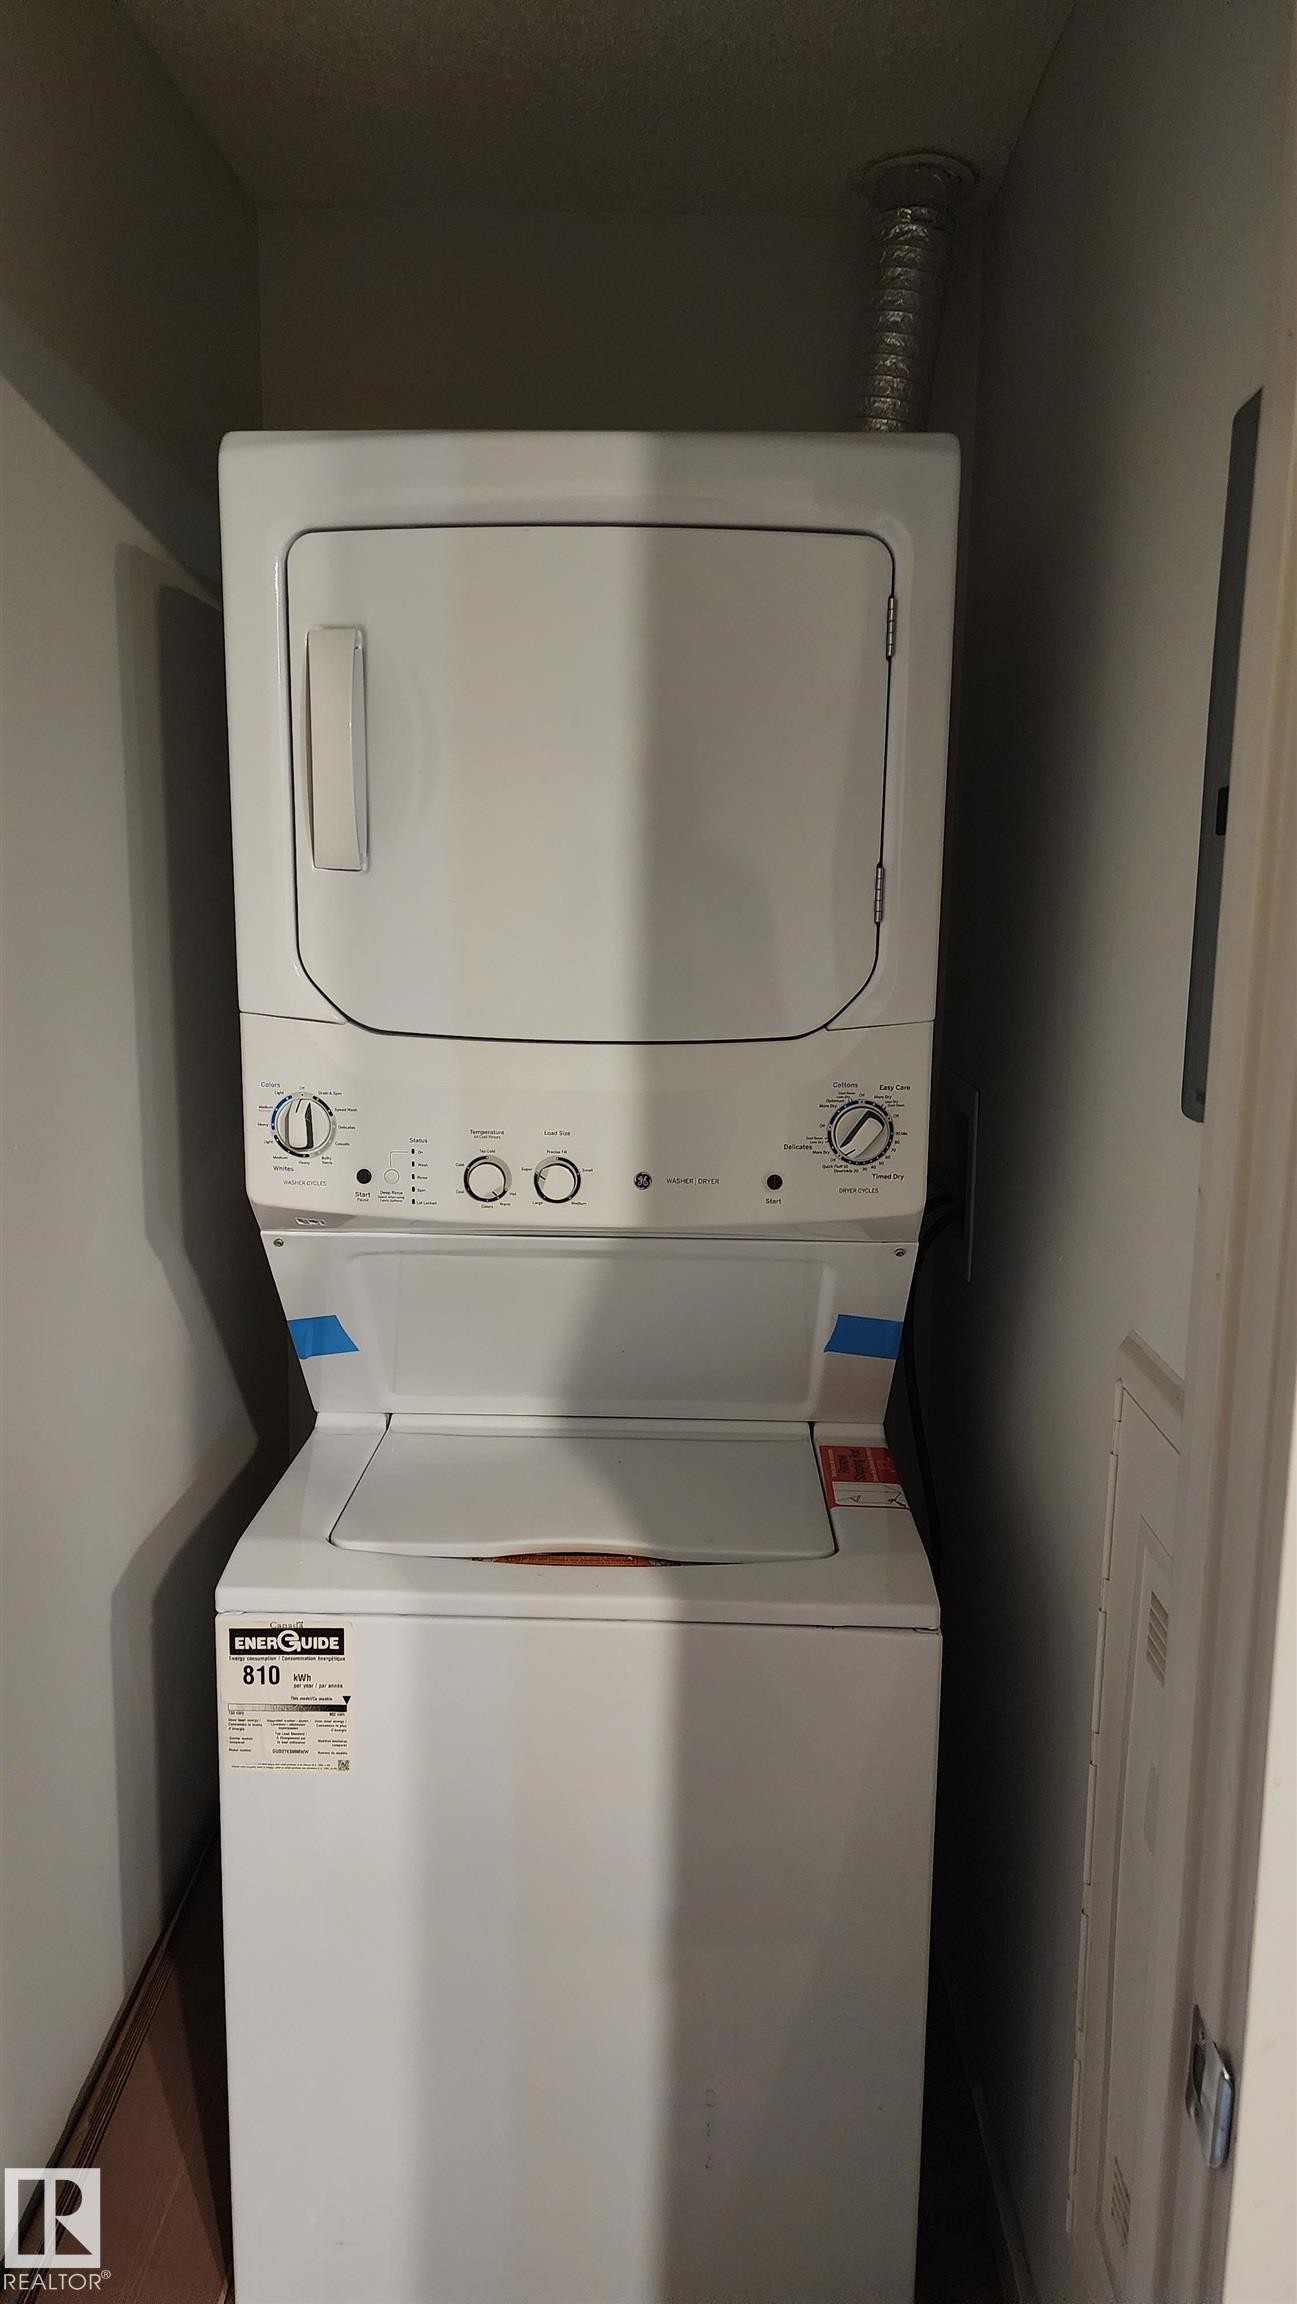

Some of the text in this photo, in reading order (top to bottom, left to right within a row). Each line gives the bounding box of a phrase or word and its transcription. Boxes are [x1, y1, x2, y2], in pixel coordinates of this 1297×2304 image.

[893, 1173, 905, 1181] Dry
[234, 1629, 340, 1653] ENERGUIDE
[243, 1665, 280, 1685] 810
[293, 1673, 312, 1682] kWh
